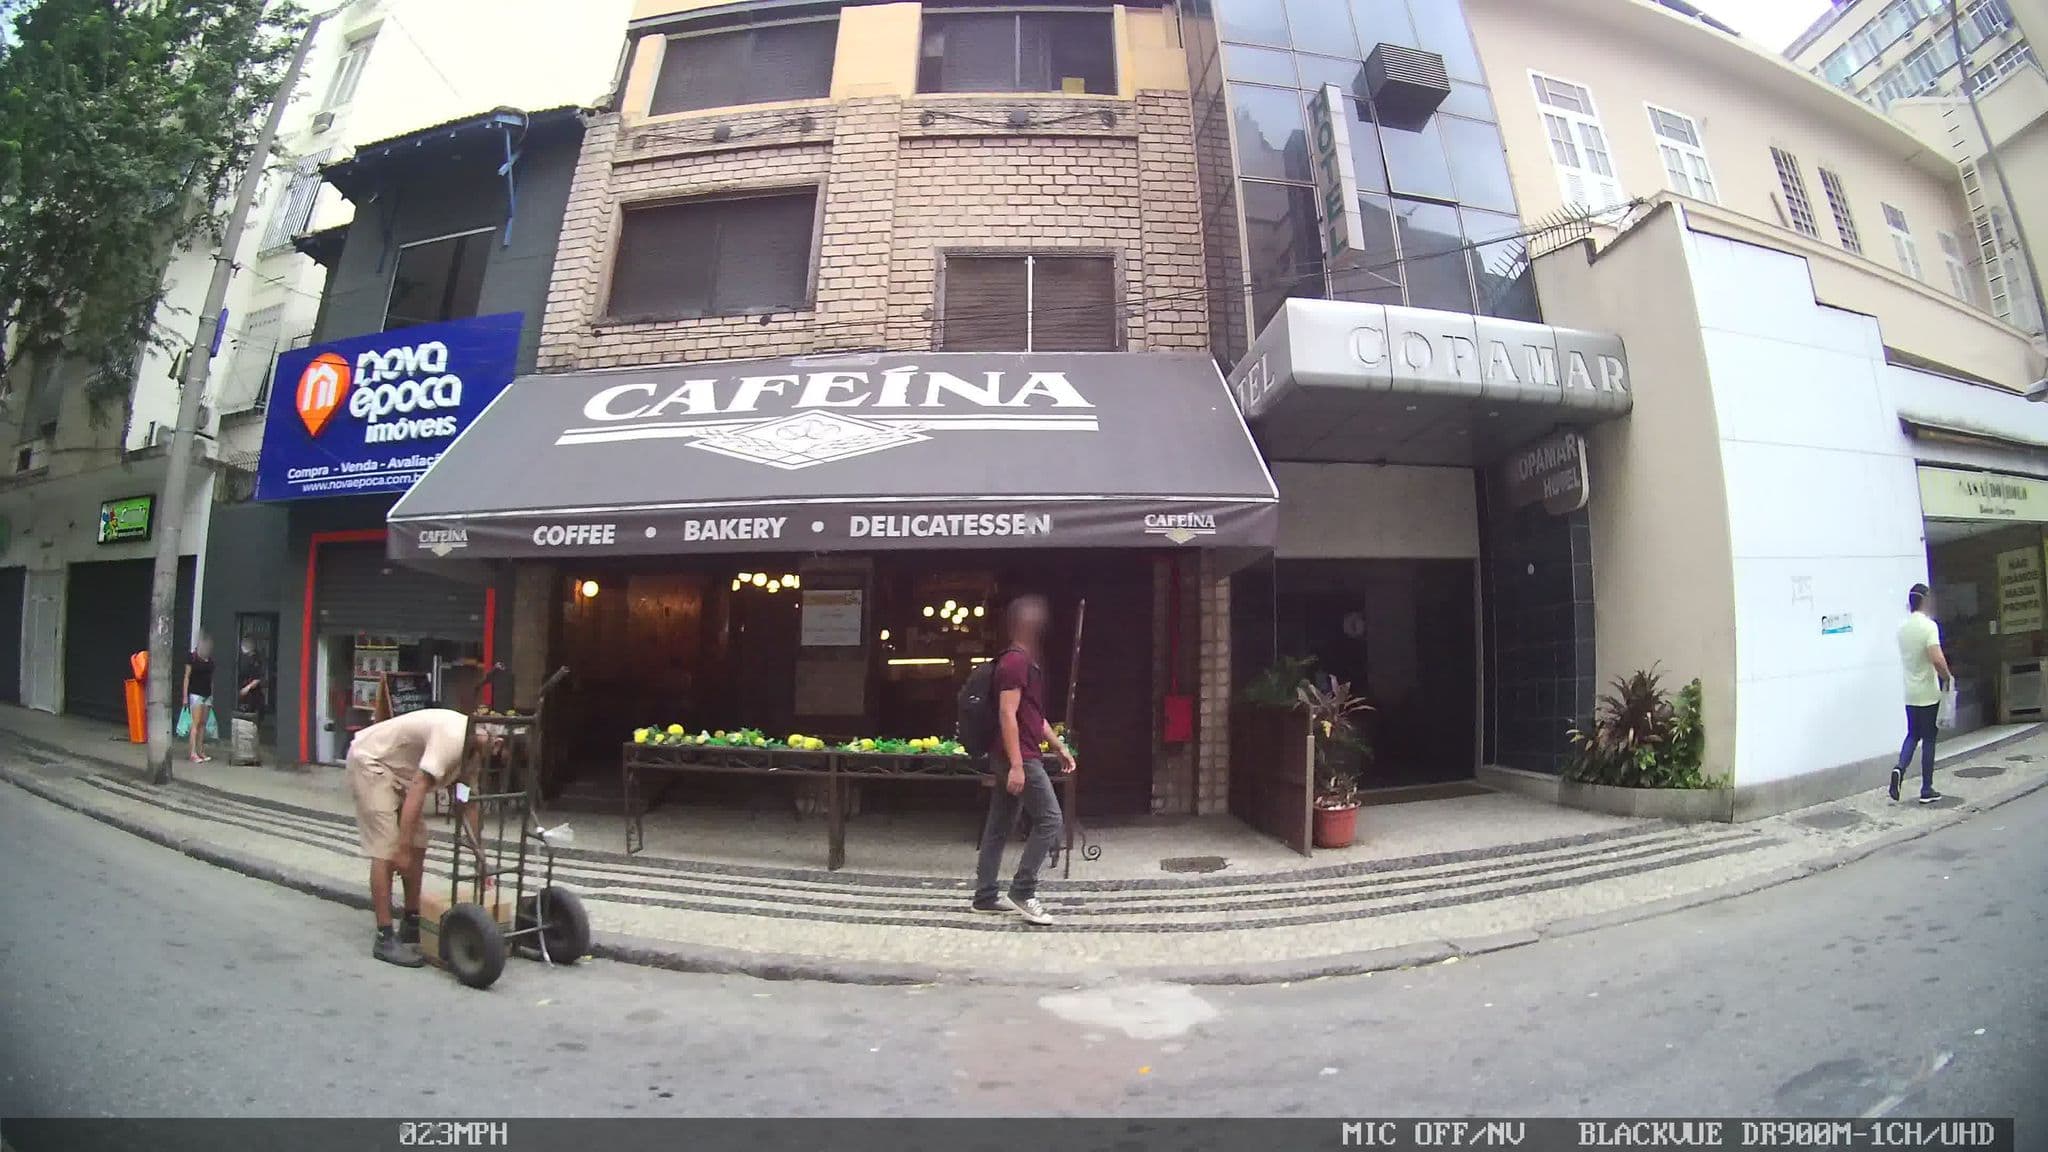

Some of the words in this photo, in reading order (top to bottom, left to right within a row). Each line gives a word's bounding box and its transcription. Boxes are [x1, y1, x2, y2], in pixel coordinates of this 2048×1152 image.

[353, 341, 447, 385] nova
[1350, 326, 1629, 393] COPAMAR
[349, 374, 462, 423] época
[583, 366, 1096, 421] CAFEÍNA
[365, 415, 458, 443] imóveis
[287, 465, 329, 479] Compra
[340, 460, 378, 473] Venda
[533, 524, 616, 546] COFFEE
[683, 517, 787, 541] BAKERY
[850, 513, 1051, 538] DELICATESSEN
[1144, 512, 1216, 528] CAFEÍNA
